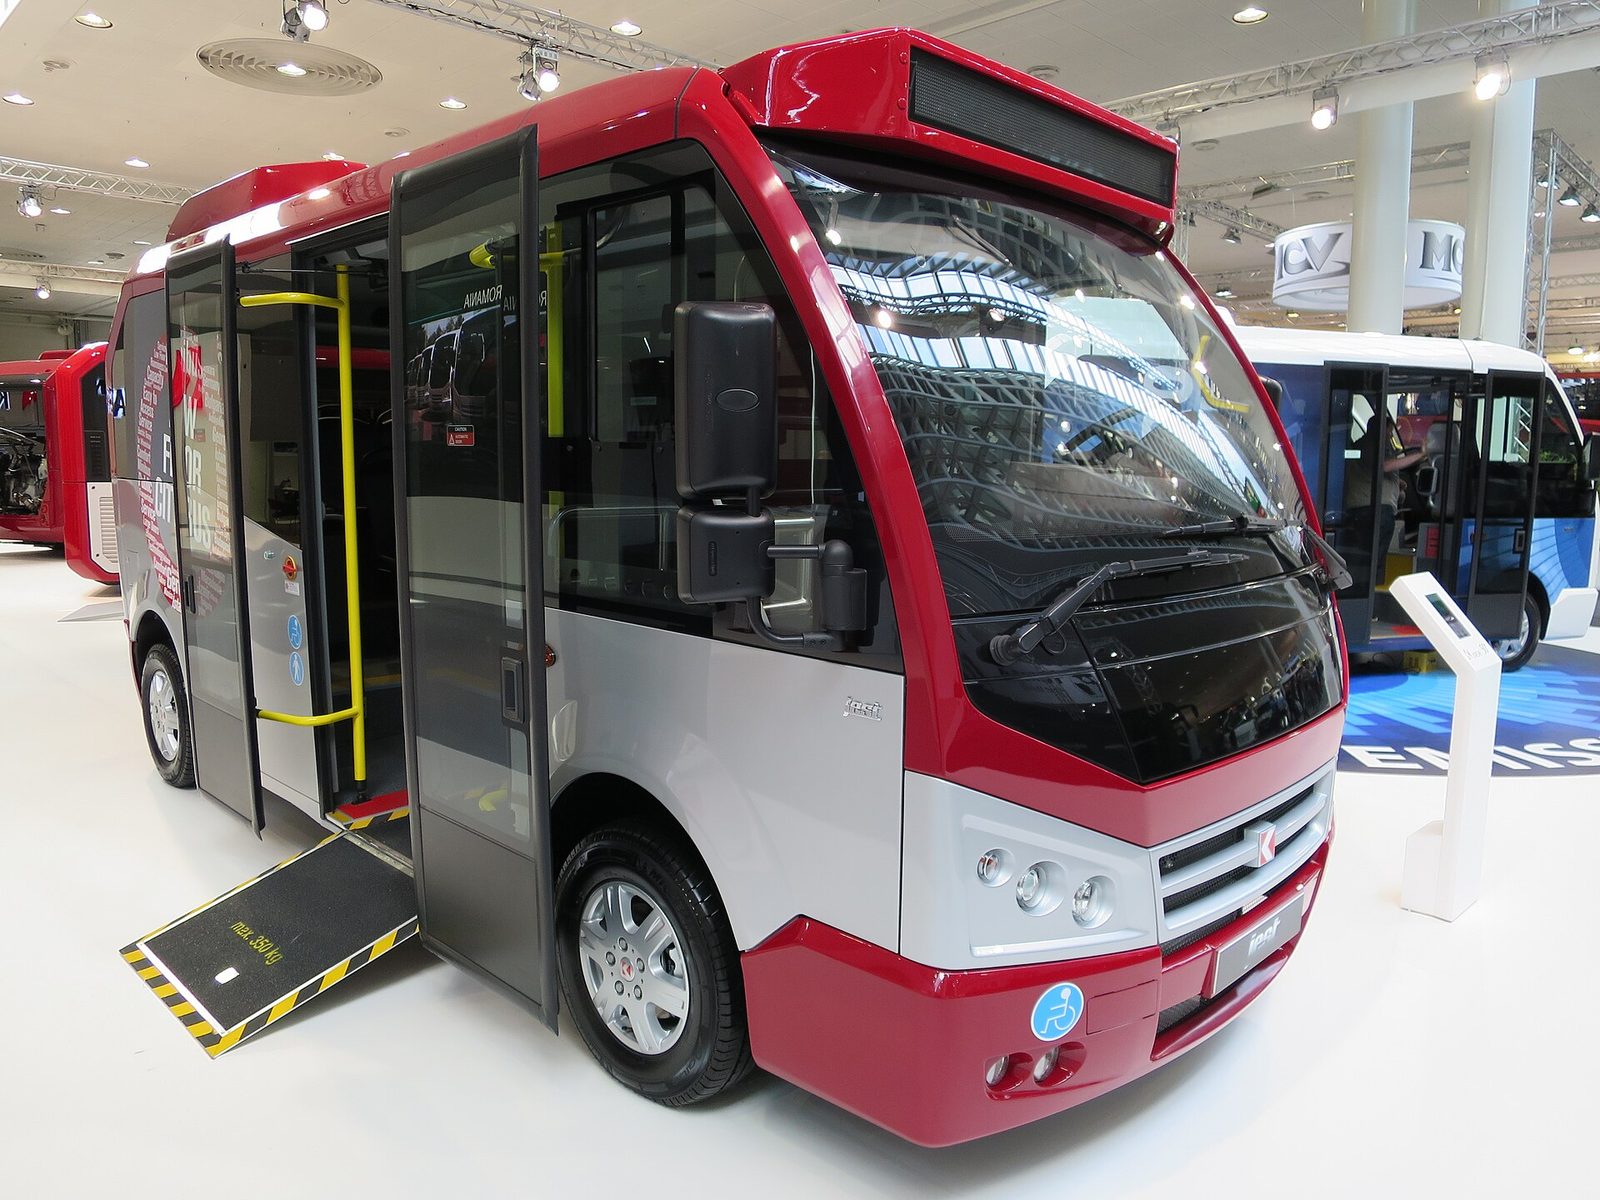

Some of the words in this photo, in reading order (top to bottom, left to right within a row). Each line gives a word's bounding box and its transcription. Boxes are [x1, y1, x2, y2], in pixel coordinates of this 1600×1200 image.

[842, 695, 882, 721] jest
[229, 920, 254, 941] max.
[249, 935, 274, 953] 350
[264, 946, 283, 965] kg
